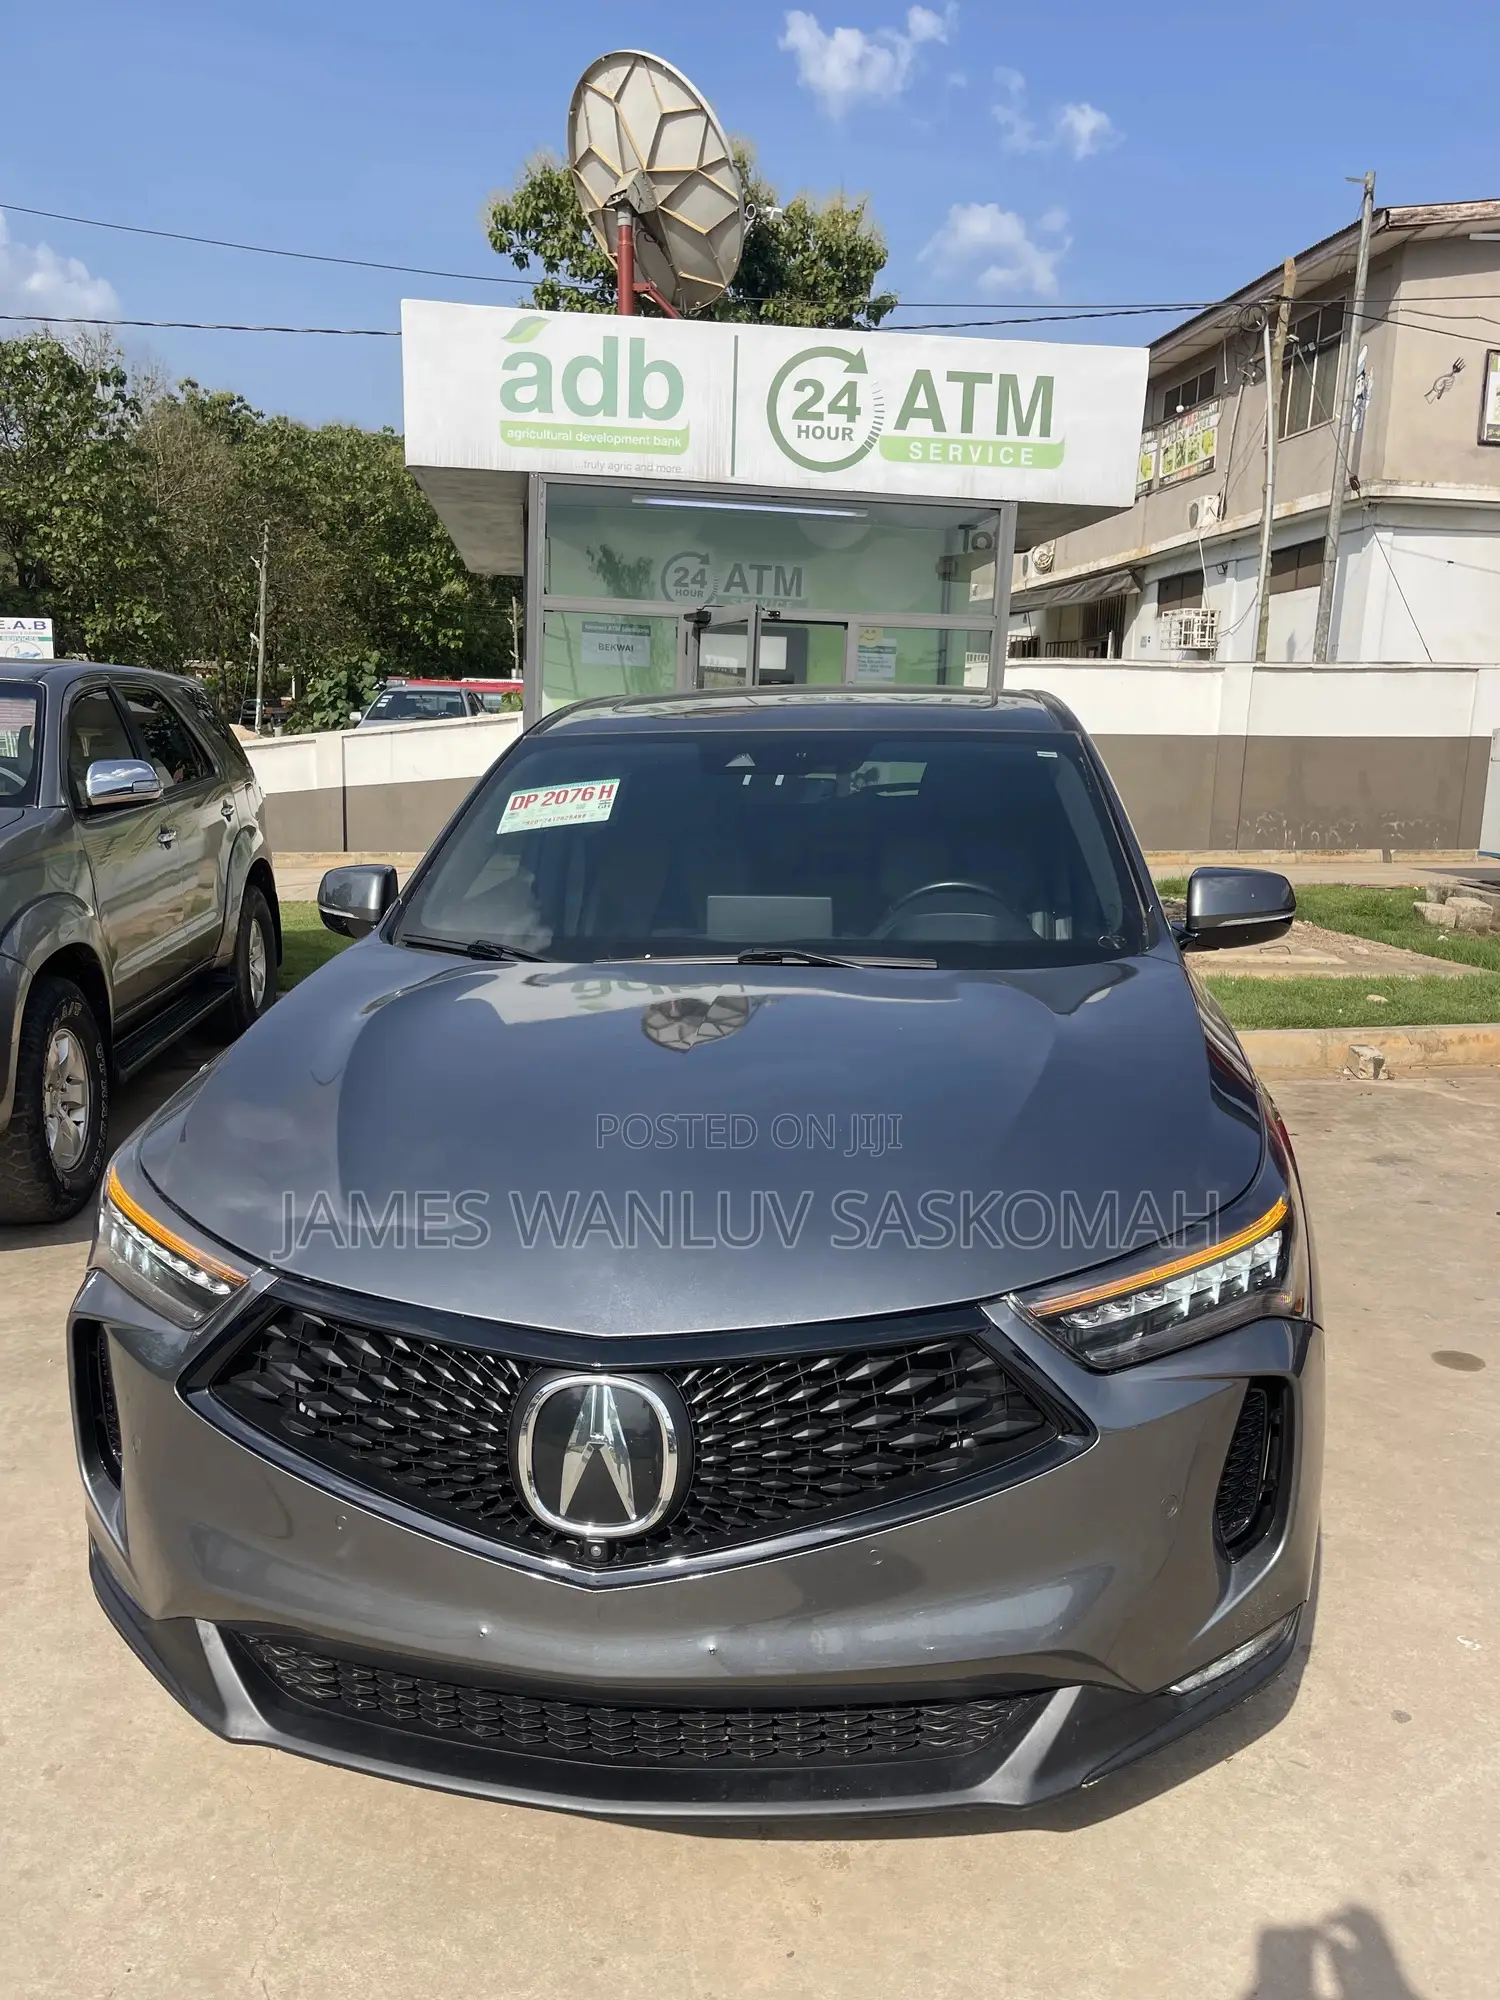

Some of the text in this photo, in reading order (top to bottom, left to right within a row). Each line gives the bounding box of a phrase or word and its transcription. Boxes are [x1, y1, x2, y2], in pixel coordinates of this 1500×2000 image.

[792, 378, 862, 423] 24
[893, 369, 1055, 438] ATM
[507, 428, 682, 447] agricultural development bank
[796, 424, 854, 442] HOUR
[908, 442, 1034, 466] SERVICE
[607, 461, 632, 473] agric
[634, 461, 654, 472] and
[673, 566, 708, 589] 24
[723, 562, 803, 598] ATM
[675, 588, 704, 598] HOUR
[598, 642, 634, 653] BEKWAI
[510, 784, 615, 811] DP 2076 H
